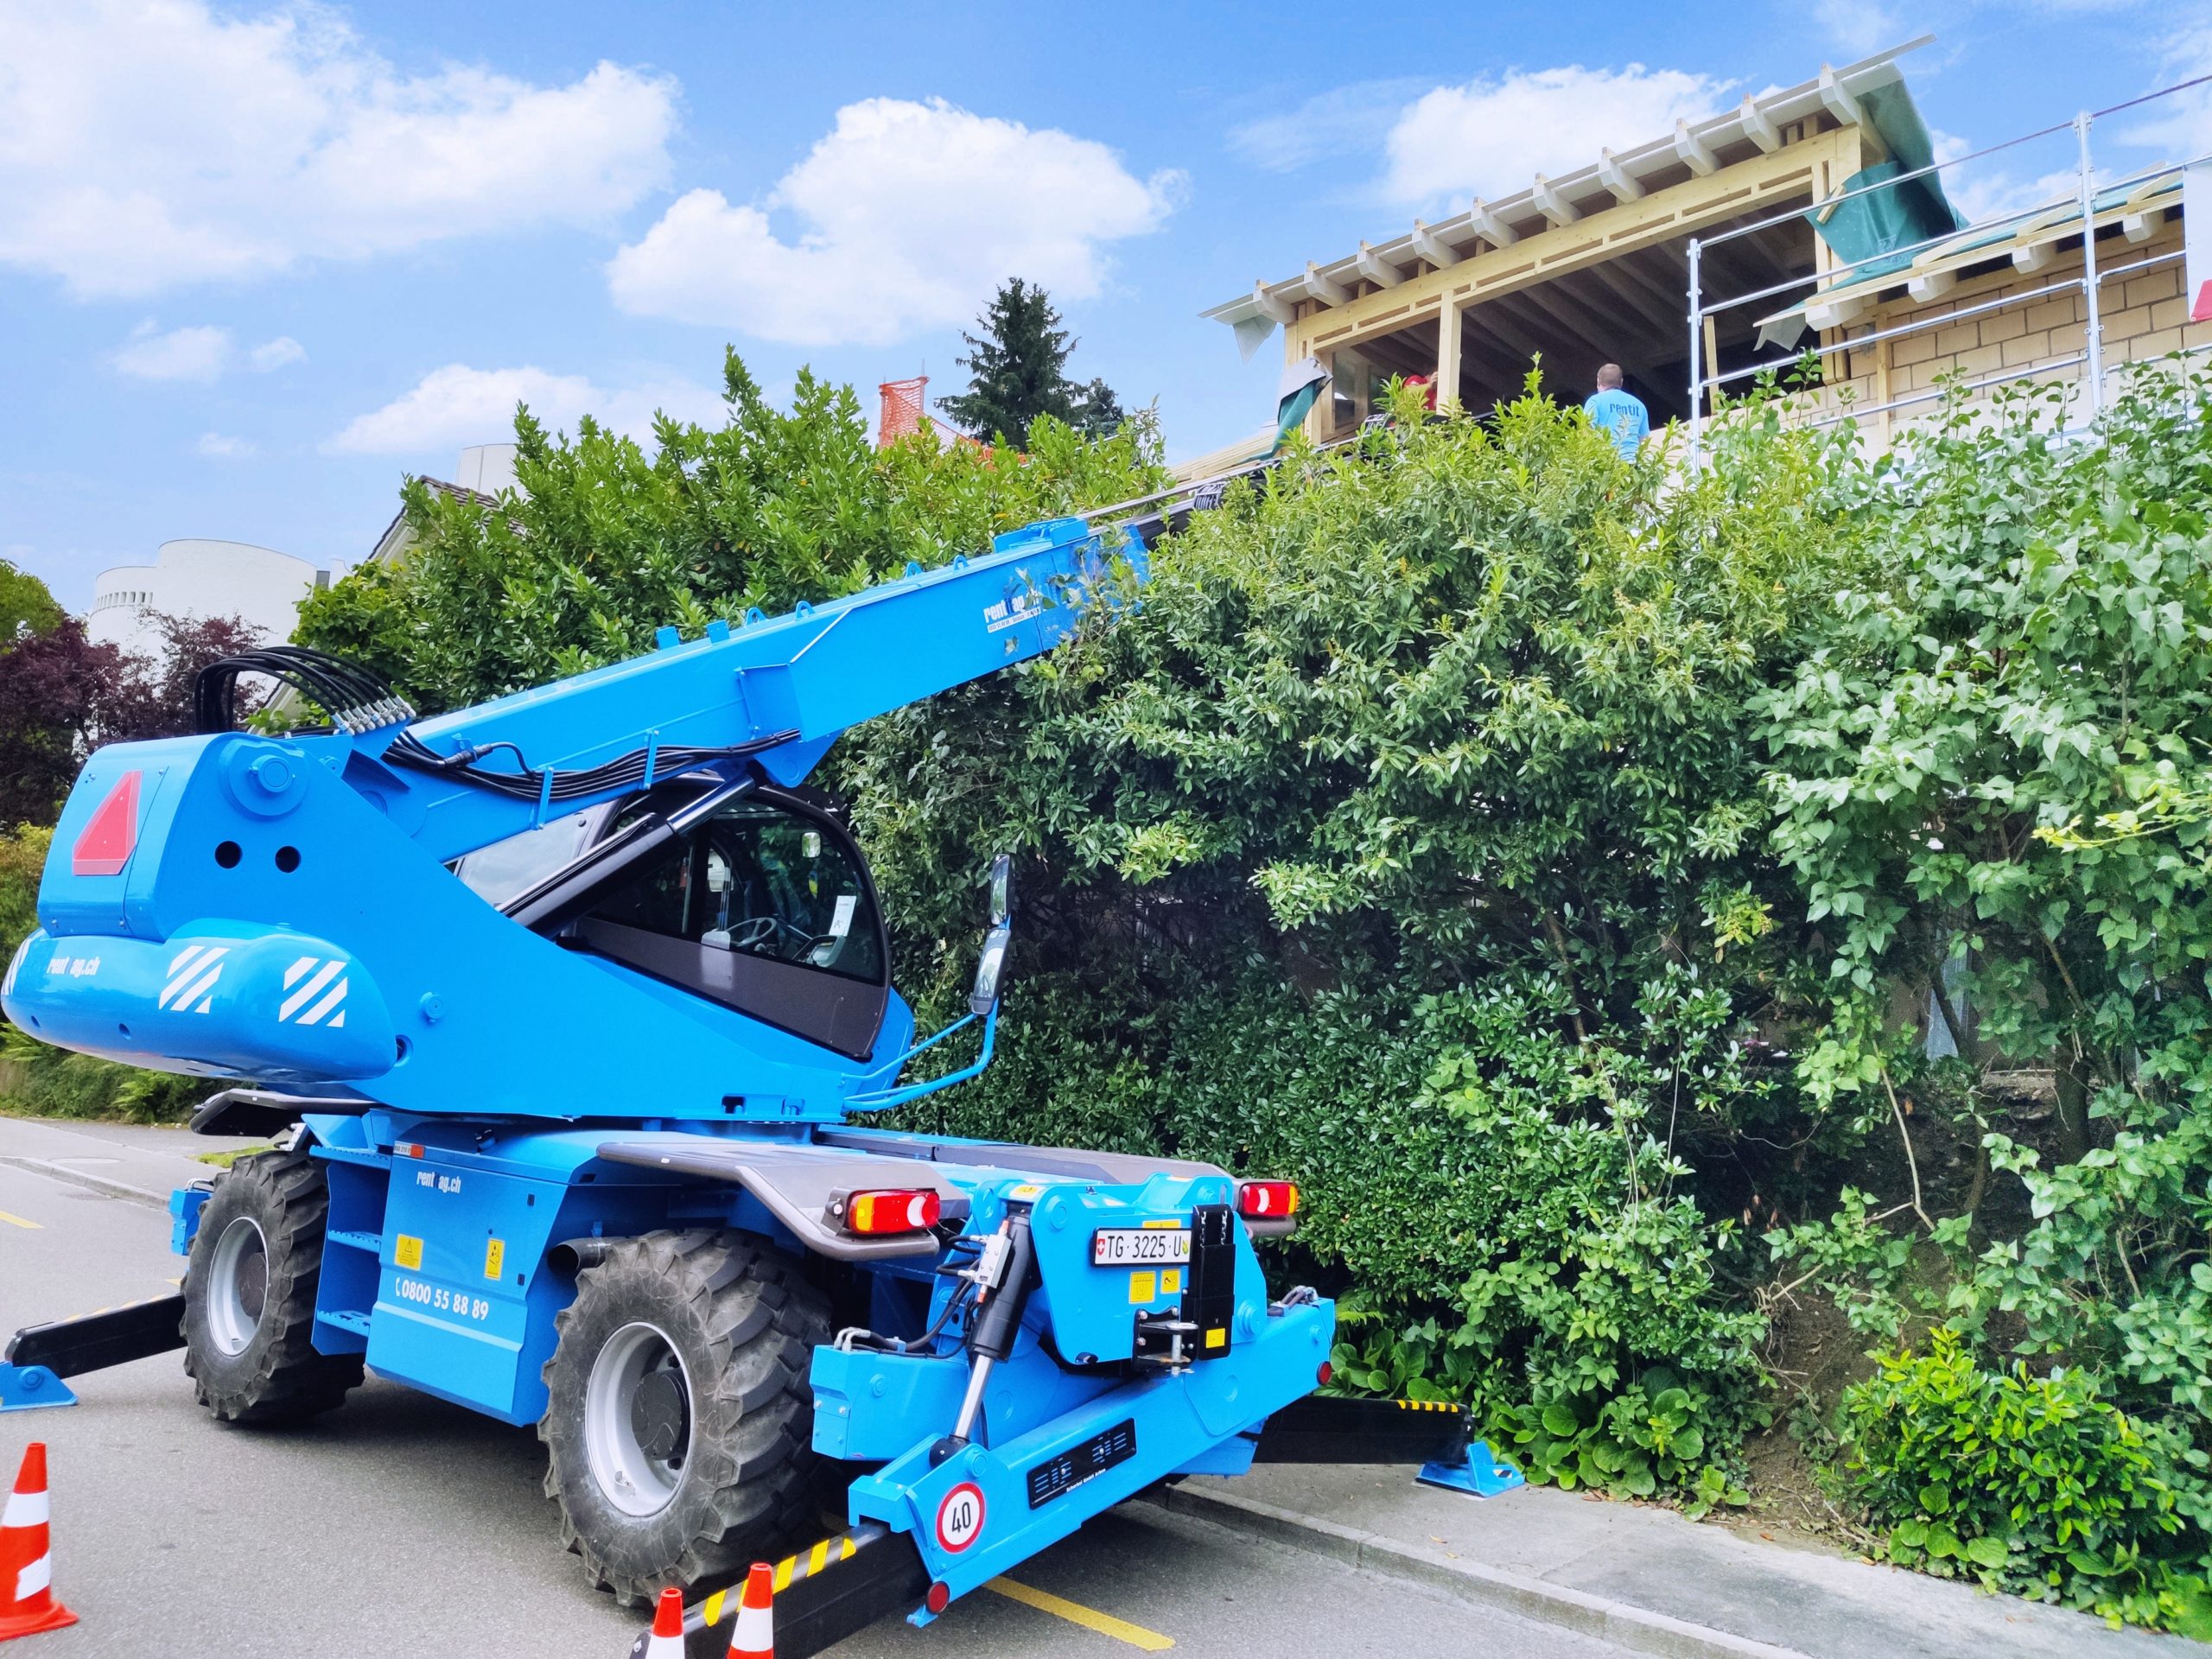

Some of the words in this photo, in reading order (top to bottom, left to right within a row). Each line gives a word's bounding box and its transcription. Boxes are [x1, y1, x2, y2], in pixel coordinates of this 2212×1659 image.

[401, 1279, 432, 1306] 0800
[433, 1288, 450, 1310] 55
[452, 1293, 469, 1315] 88
[471, 1299, 489, 1320] 89
[951, 1501, 971, 1534] 40
